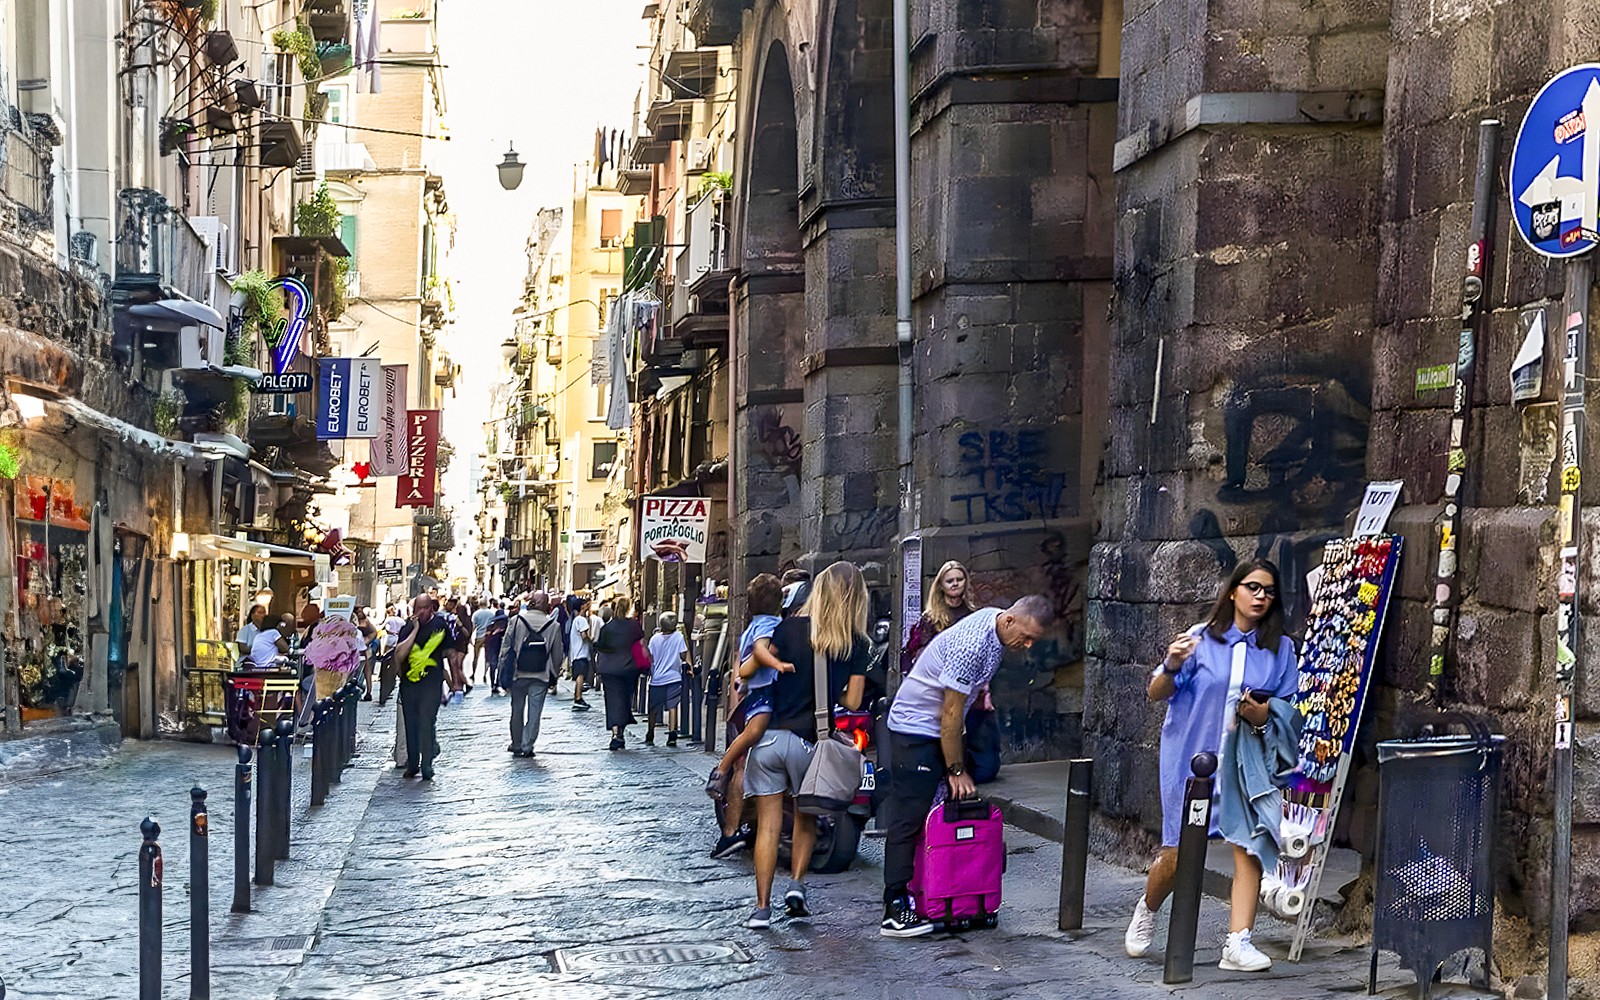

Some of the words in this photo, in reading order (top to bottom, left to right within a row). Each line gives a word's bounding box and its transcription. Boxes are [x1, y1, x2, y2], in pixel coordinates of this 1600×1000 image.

[328, 371, 343, 433] EUROBET
[357, 370, 371, 432] EUROBET
[407, 414, 428, 499] PIZZERIA
[644, 525, 704, 544] PORTAFOGLIO
[645, 499, 707, 517] PIZZA
